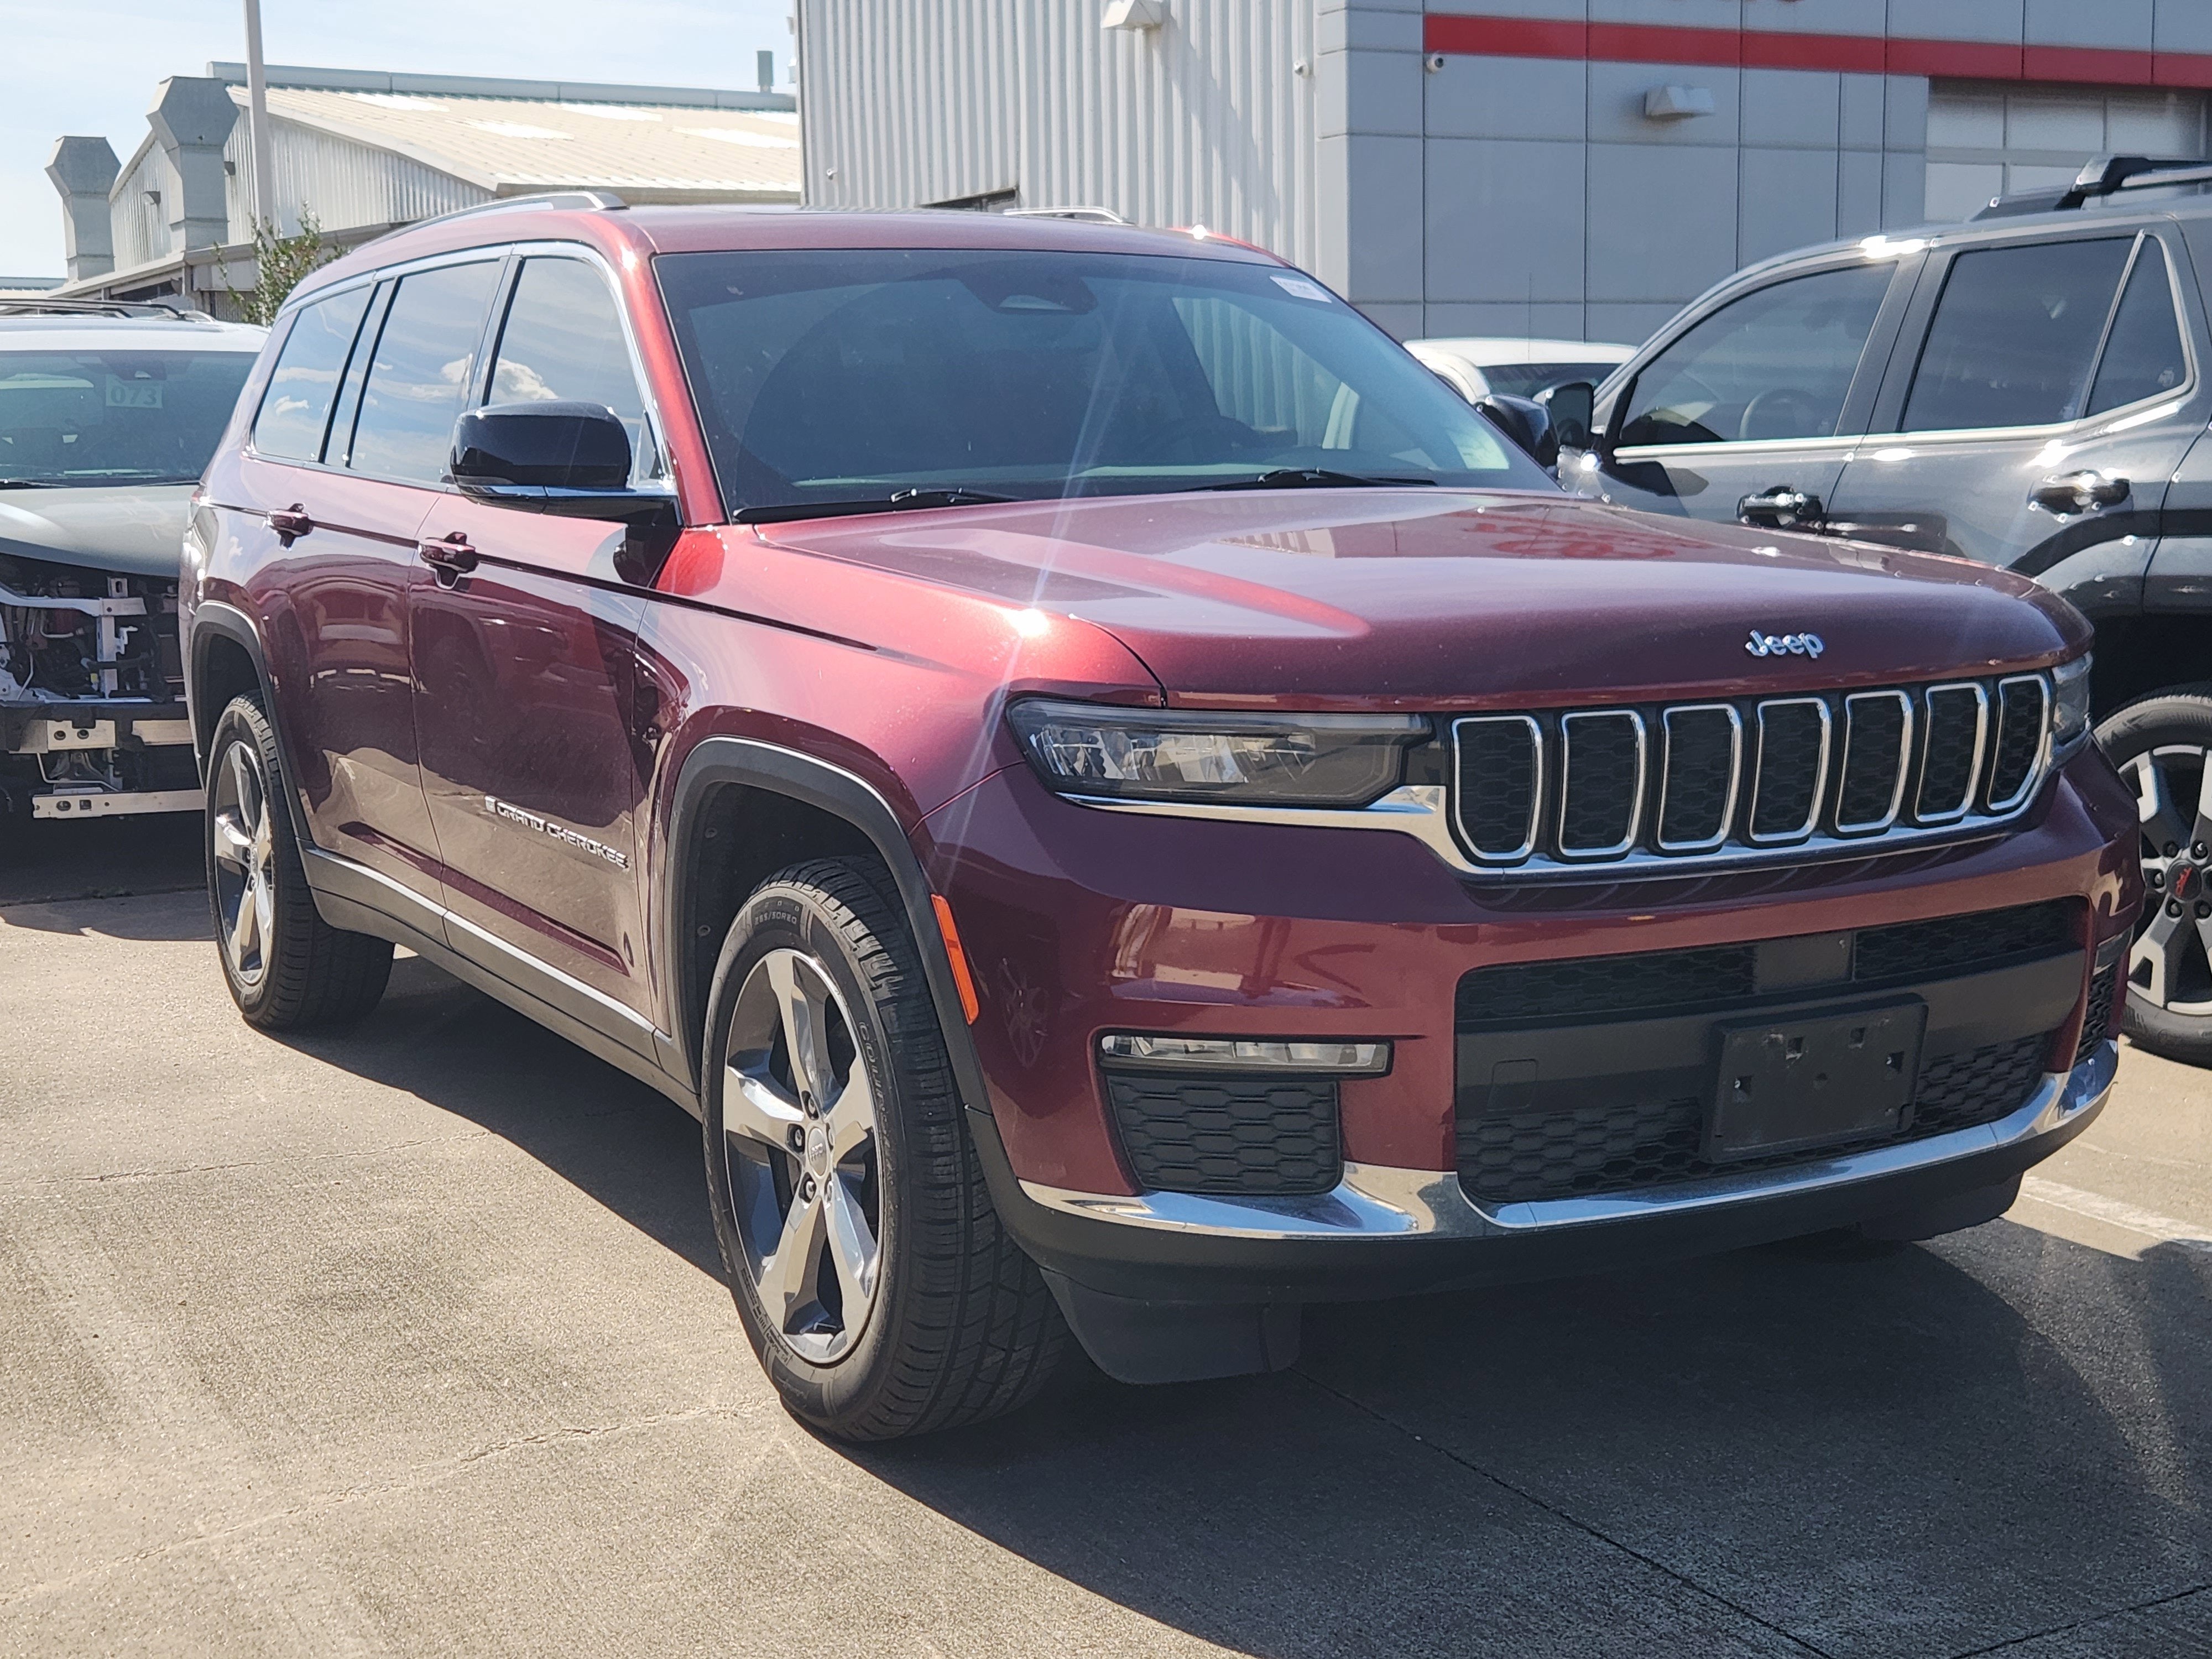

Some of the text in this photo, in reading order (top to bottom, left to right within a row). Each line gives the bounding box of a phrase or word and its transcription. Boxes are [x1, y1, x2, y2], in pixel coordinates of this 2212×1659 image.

[1745, 629, 1824, 659] Jeep
[497, 801, 629, 869] GRAND CHEROKEE
